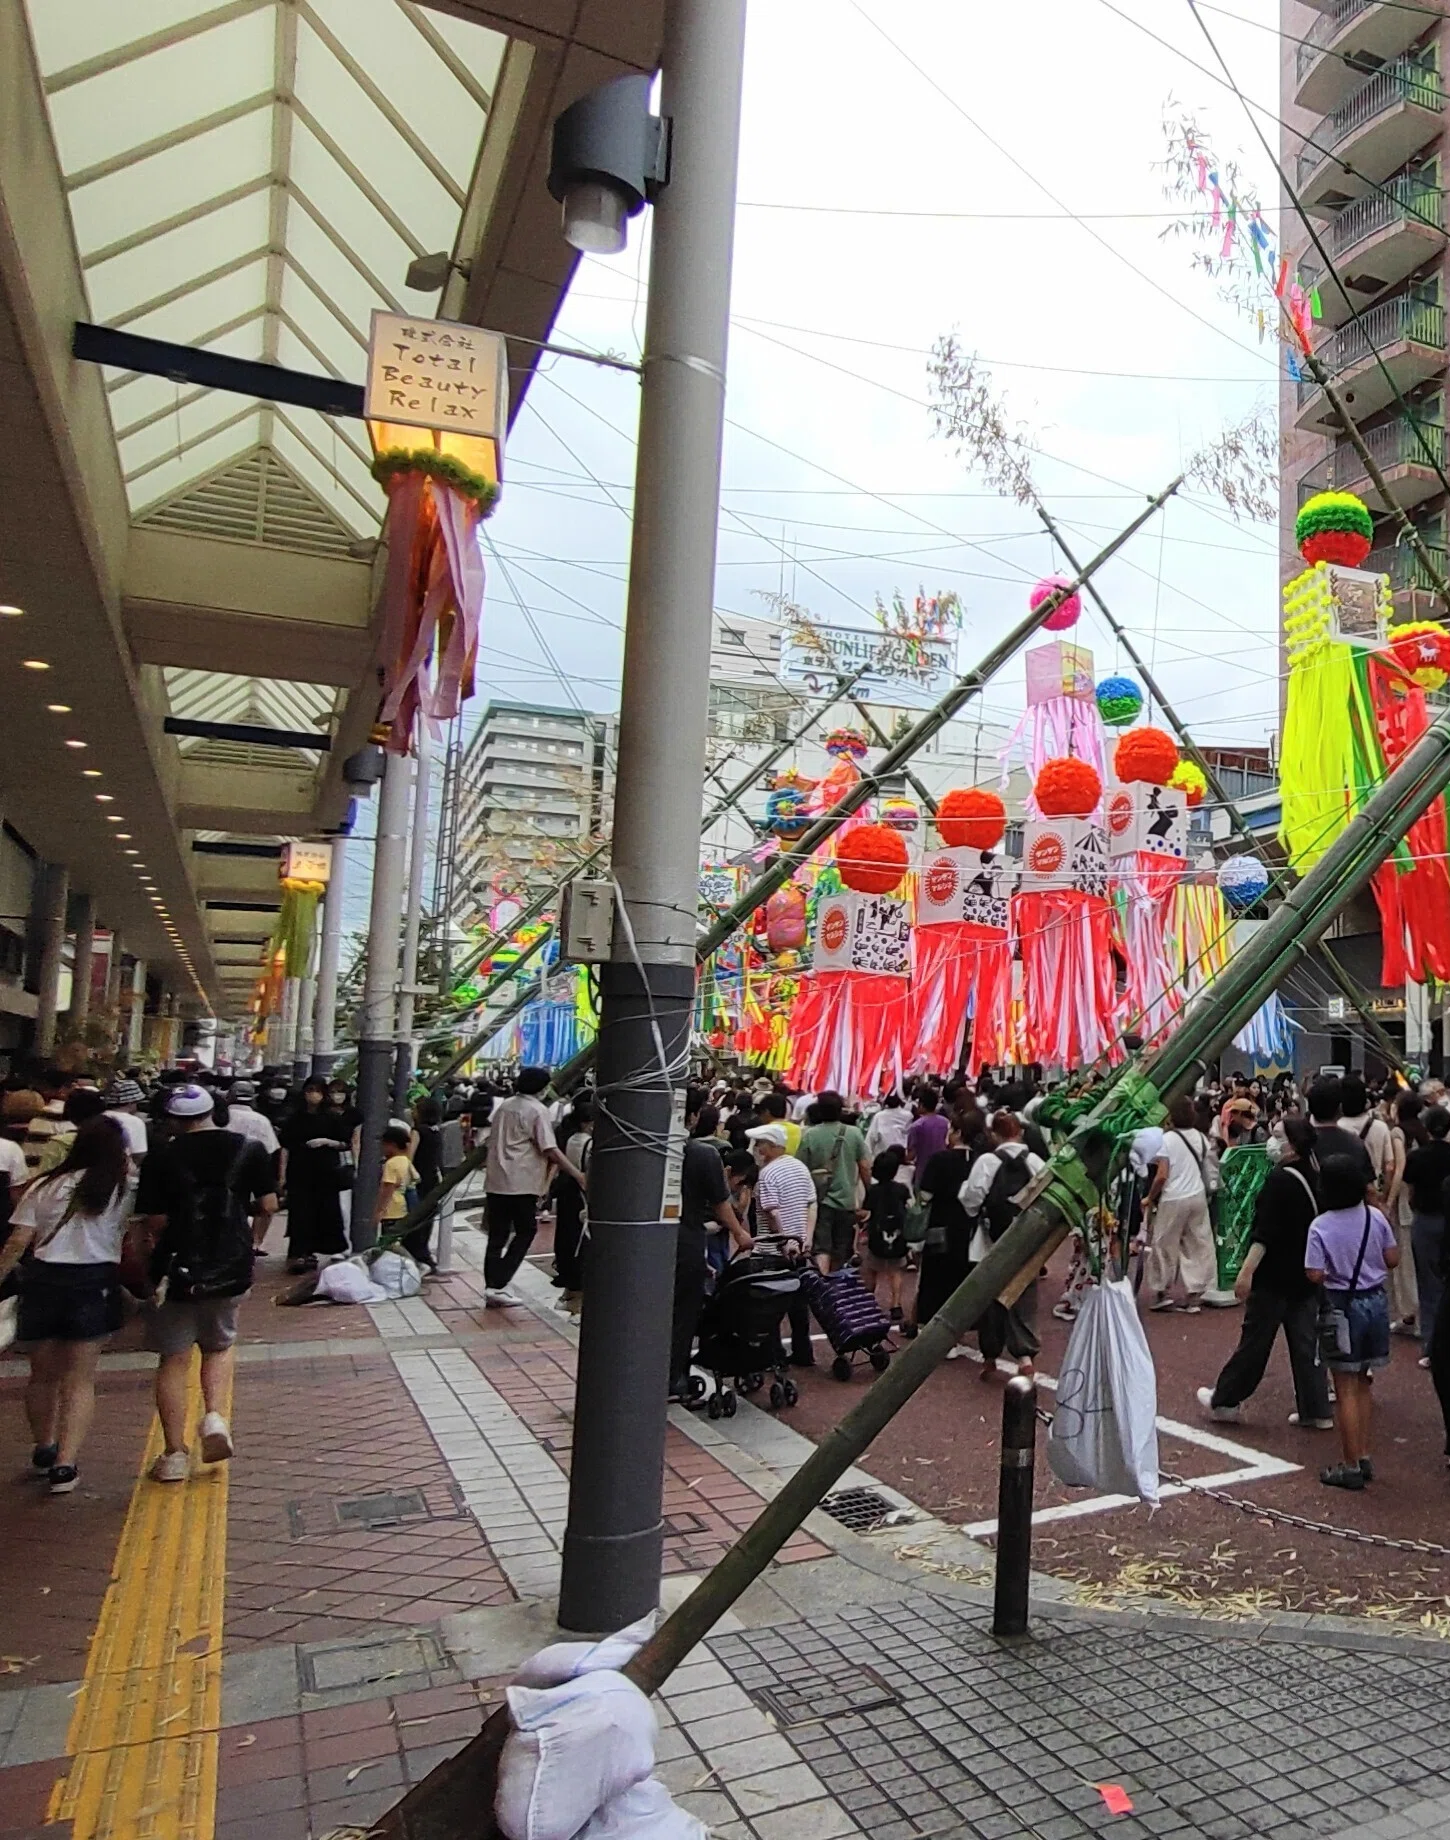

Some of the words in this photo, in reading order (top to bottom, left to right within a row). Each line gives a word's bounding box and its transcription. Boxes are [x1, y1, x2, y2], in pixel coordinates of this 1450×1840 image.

[400, 327, 475, 350] 株式会社
[393, 343, 476, 373] Total
[382, 365, 487, 399] Beauty
[389, 390, 479, 419] Relax
[825, 631, 868, 642] HOTEL
[826, 639, 887, 661] SUNLIF
[892, 648, 949, 668] GADEN
